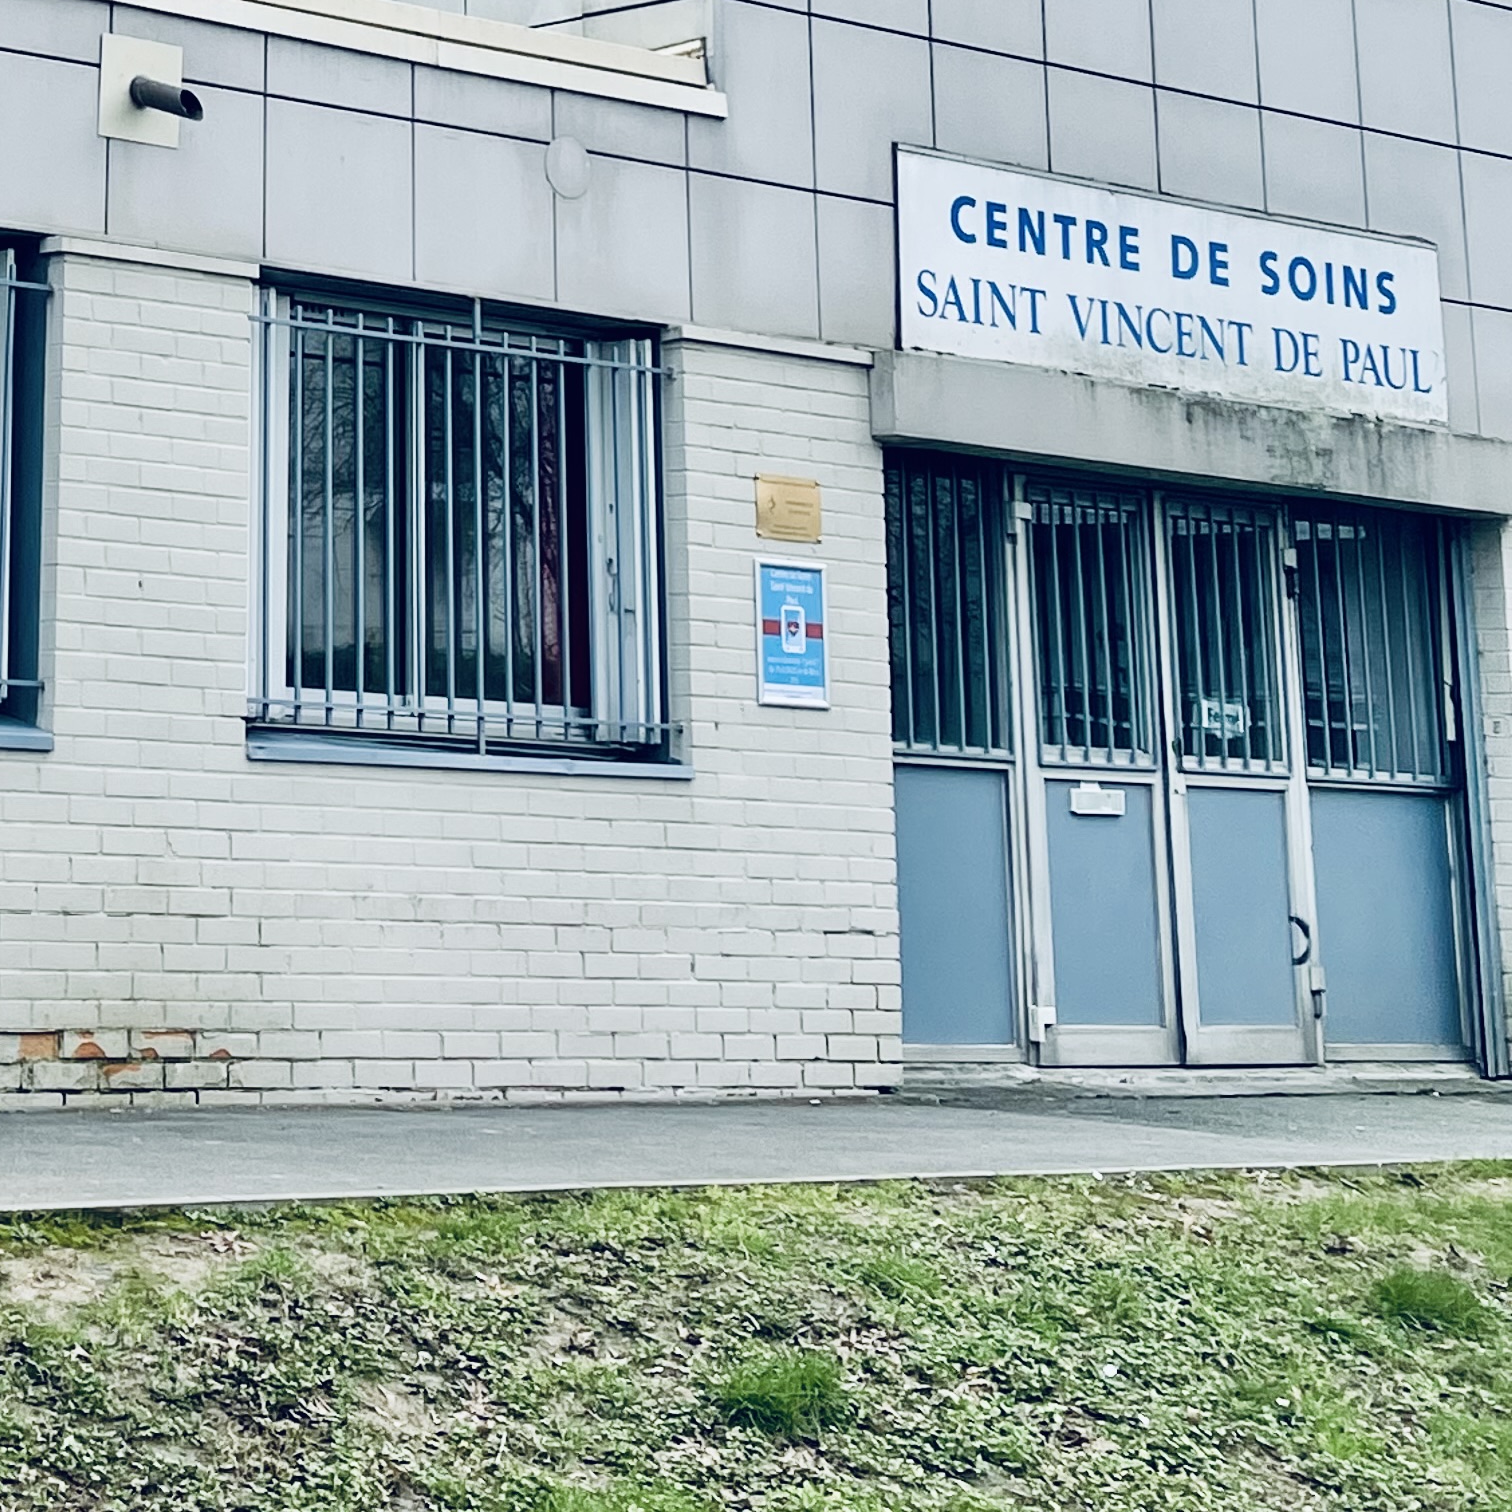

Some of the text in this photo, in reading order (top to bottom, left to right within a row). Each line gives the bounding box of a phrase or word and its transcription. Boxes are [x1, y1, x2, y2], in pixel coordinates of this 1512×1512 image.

[949, 193, 1398, 316] CENTRE DE SOINS
[916, 268, 1433, 394] SAINT VINCENT DE PAUL
